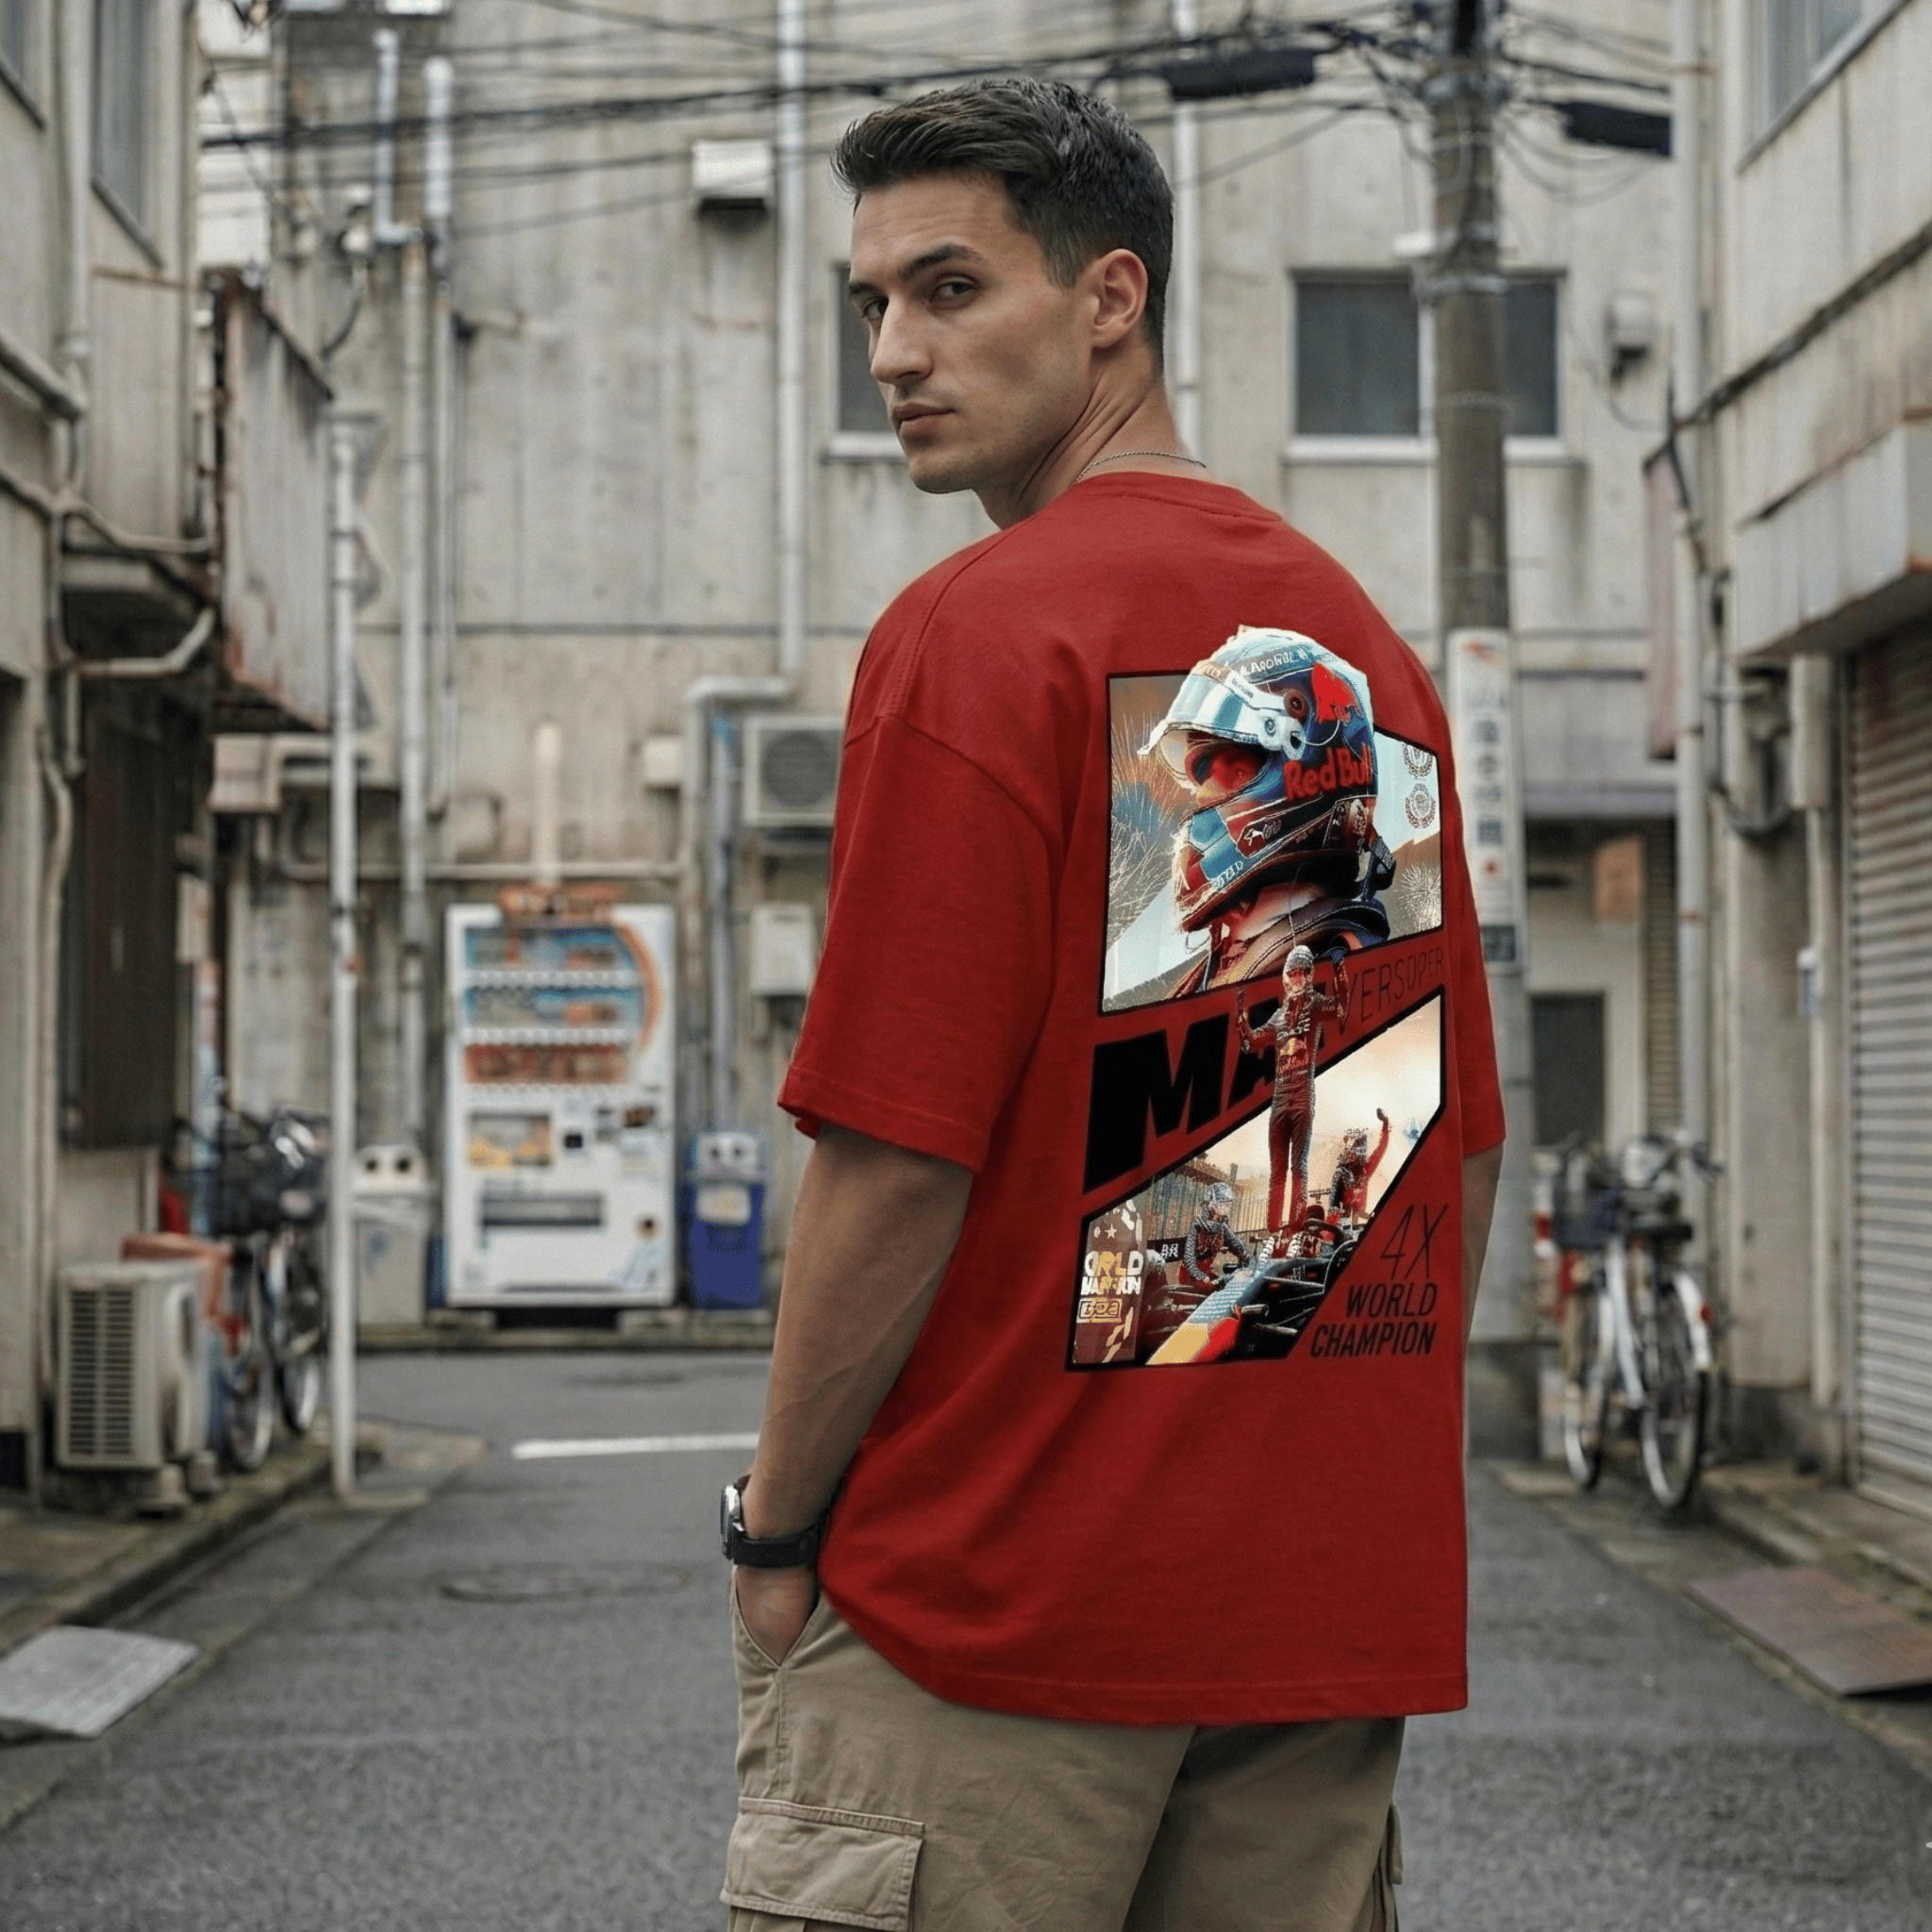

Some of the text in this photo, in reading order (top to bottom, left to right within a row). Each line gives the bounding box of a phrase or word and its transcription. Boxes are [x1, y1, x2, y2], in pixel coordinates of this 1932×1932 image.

[1284, 746, 1336, 800] Red
[1083, 981, 1325, 1194] MA
[1380, 1204, 1449, 1280] 4X
[1346, 1282, 1438, 1318] WORLD
[1310, 1322, 1438, 1358] CHAMPION
